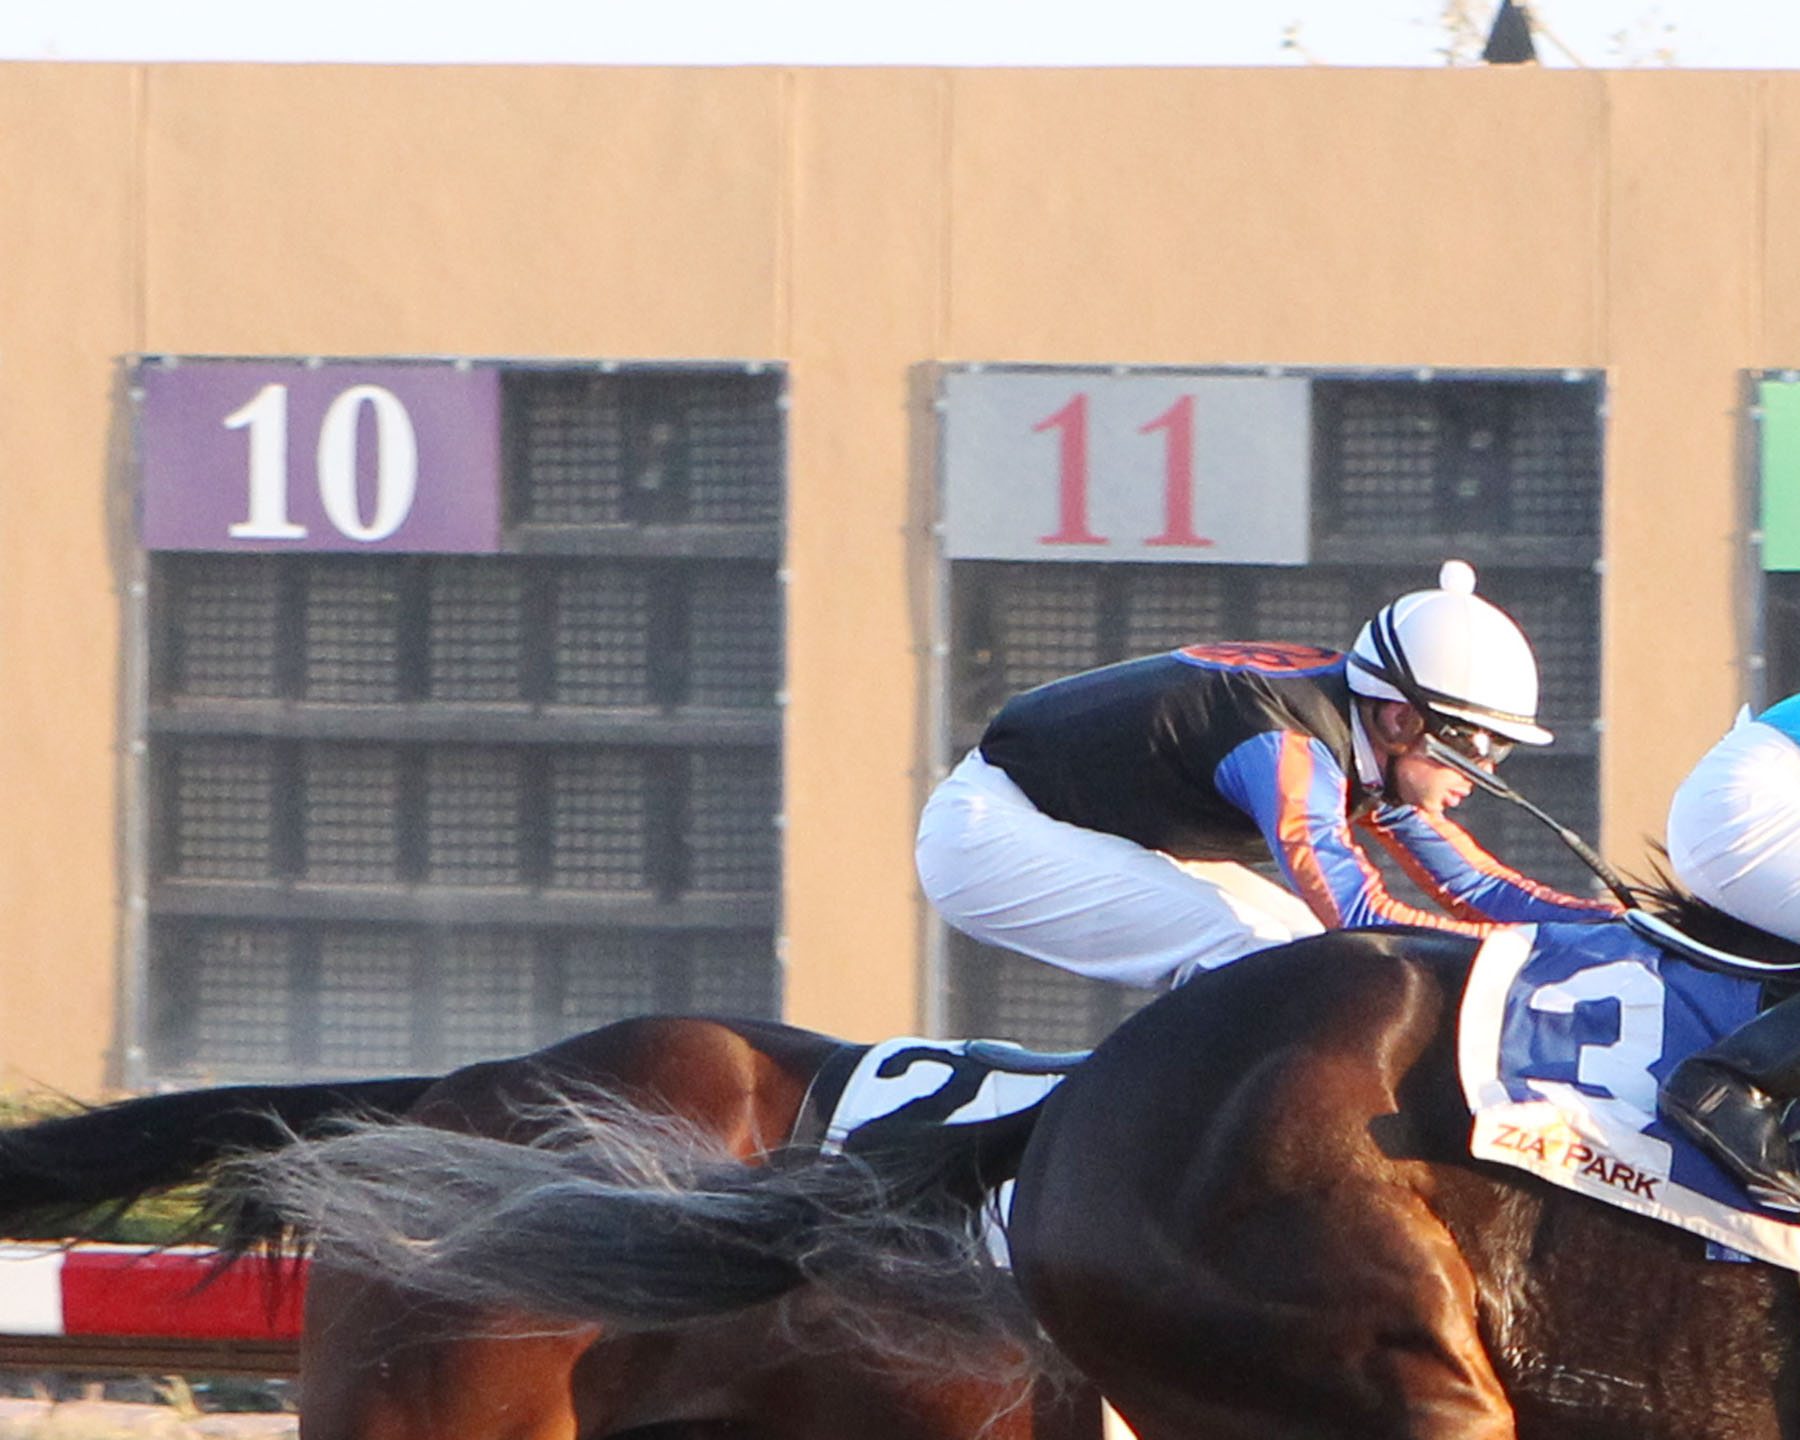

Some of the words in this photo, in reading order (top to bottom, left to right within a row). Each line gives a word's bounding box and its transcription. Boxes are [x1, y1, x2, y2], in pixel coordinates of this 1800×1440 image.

[223, 383, 419, 542] 10
[1032, 392, 1216, 548] 11
[1527, 959, 1665, 1134] 3
[1491, 1123, 1548, 1162] ZIA
[1560, 1143, 1662, 1201] PARK
